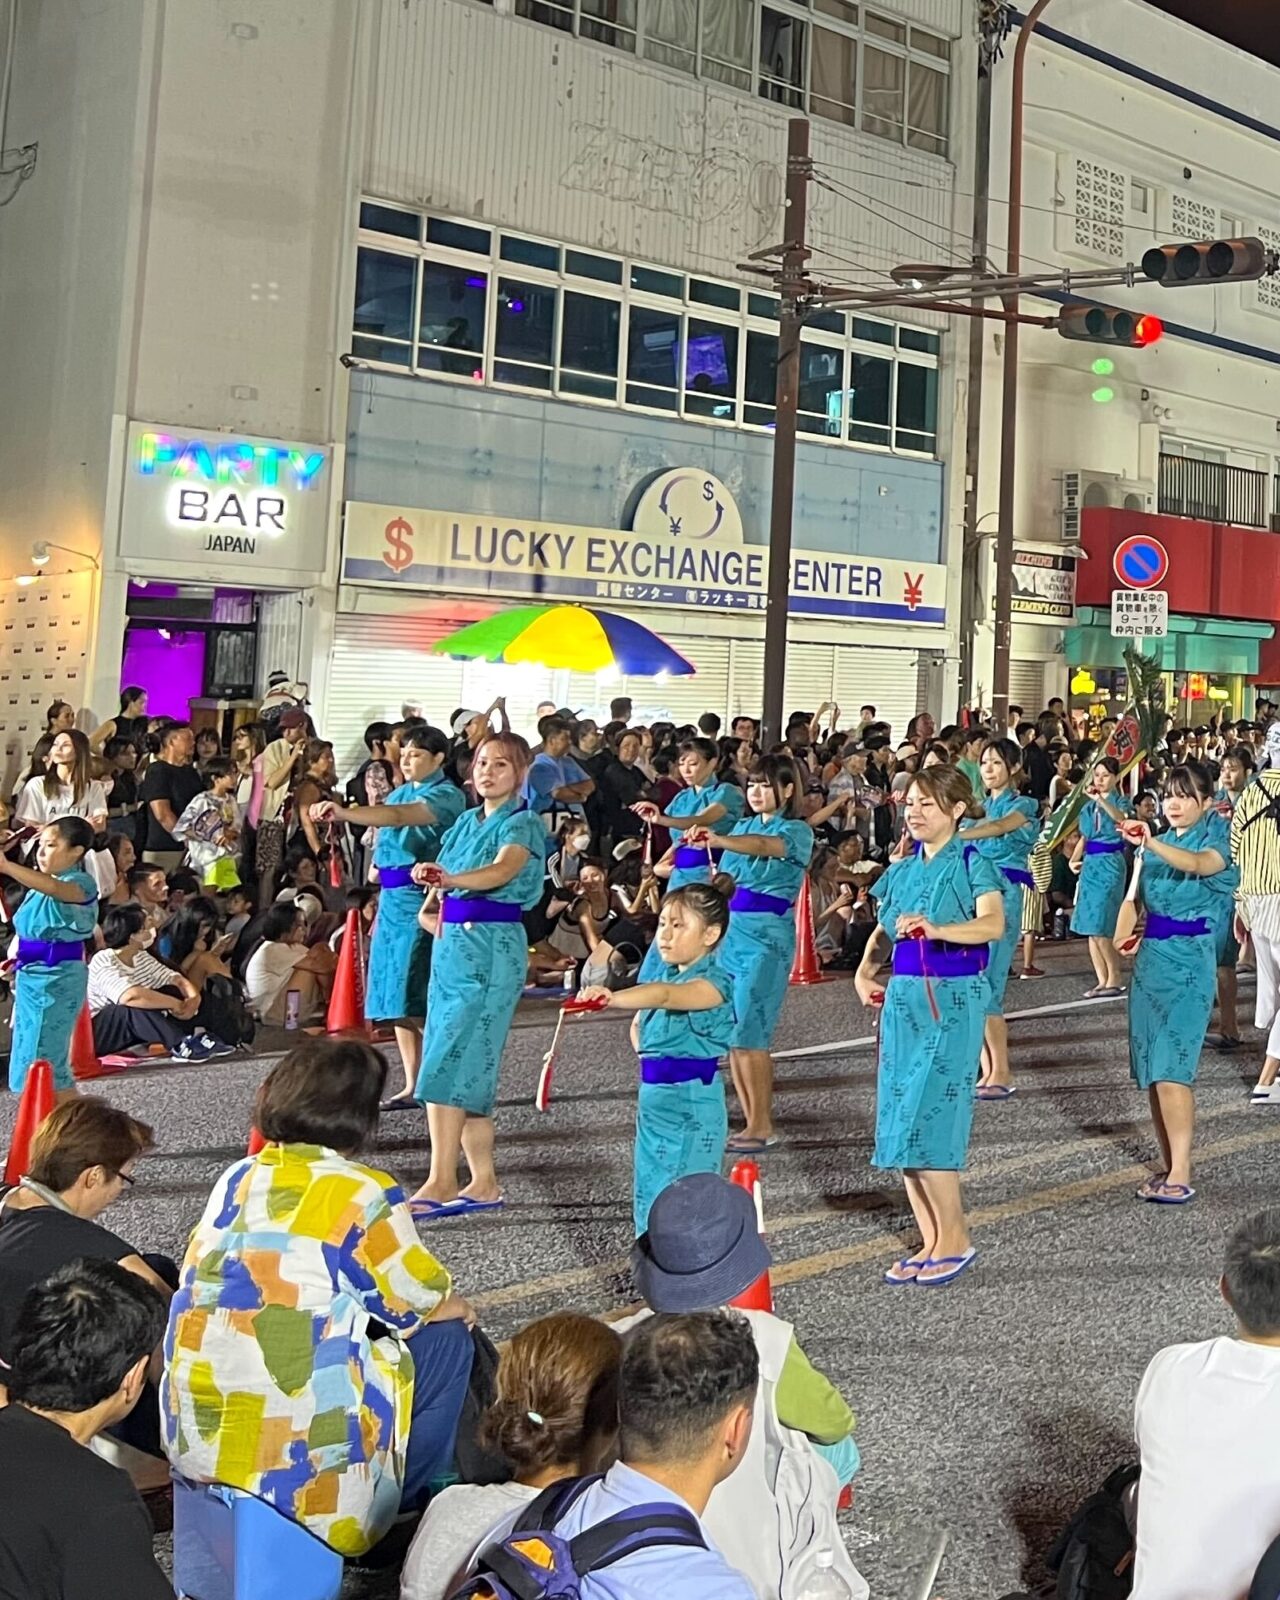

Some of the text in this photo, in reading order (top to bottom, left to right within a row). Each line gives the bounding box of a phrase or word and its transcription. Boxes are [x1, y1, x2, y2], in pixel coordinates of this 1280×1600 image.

[140, 433, 325, 490] PARTY
[178, 489, 285, 530] BAR
[205, 534, 256, 554] JAPAN
[451, 523, 575, 570] LUCKY
[586, 537, 764, 587] EXCHANGE
[793, 559, 883, 598] ENTER
